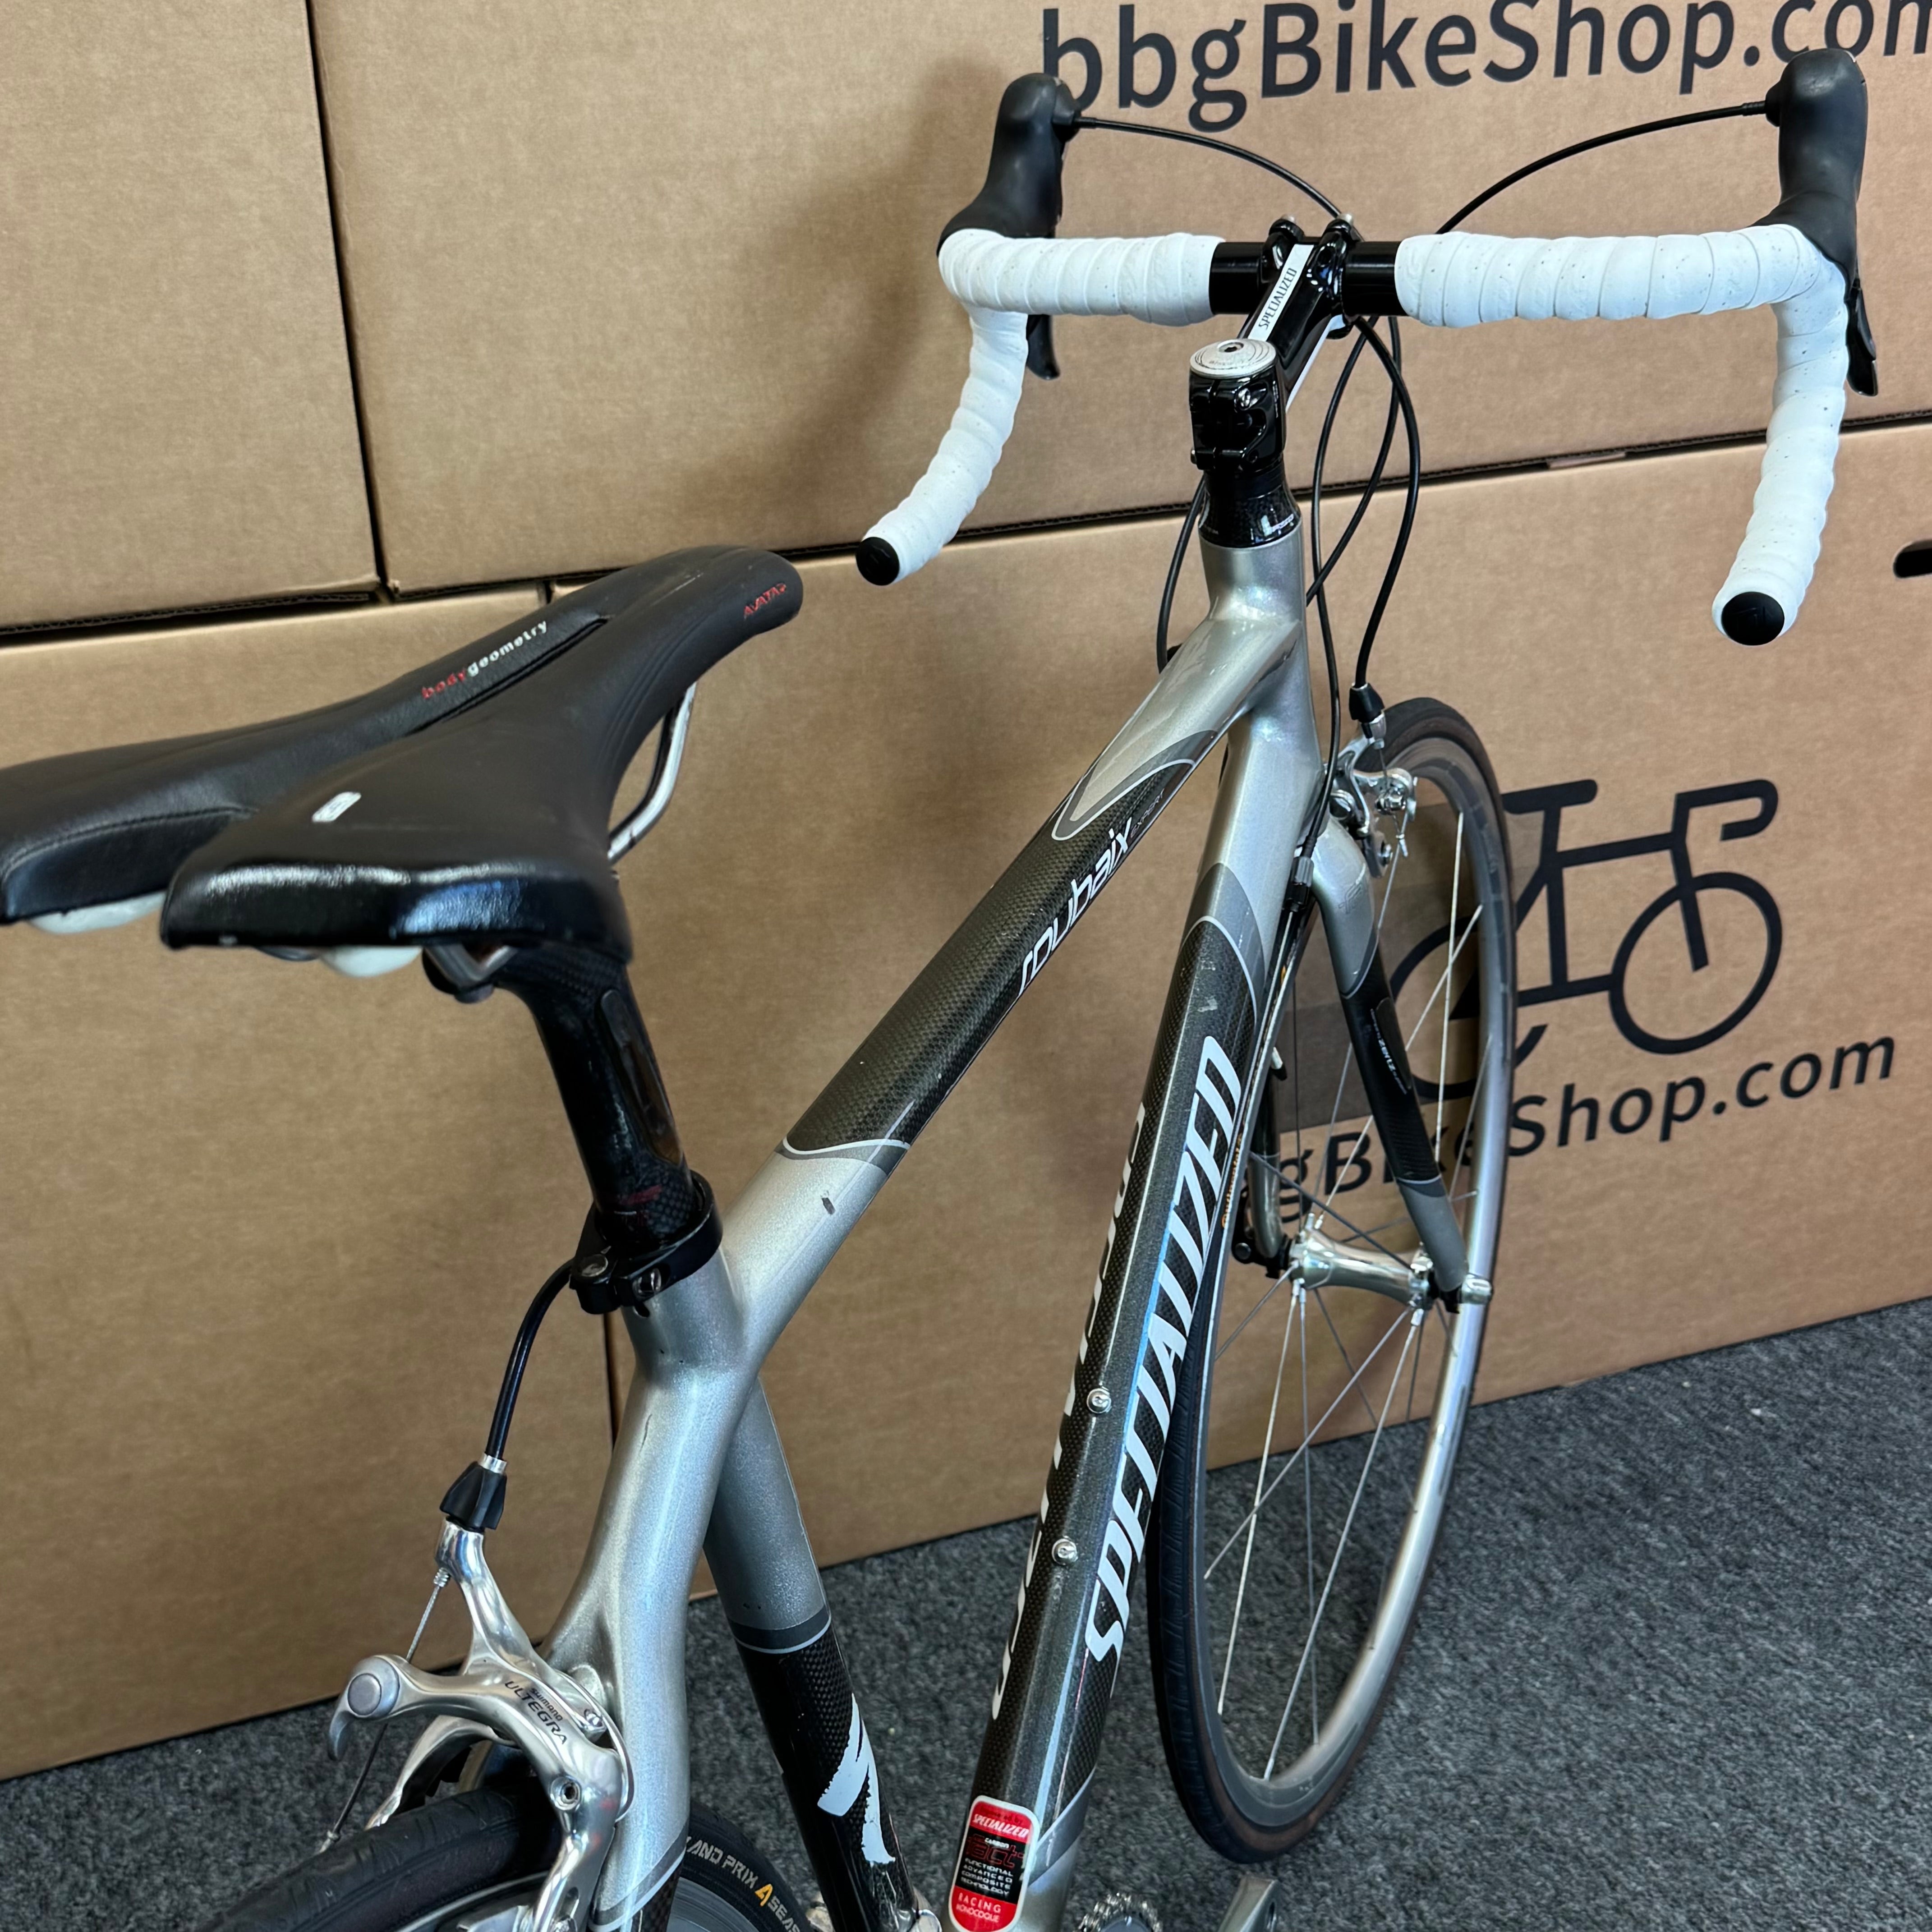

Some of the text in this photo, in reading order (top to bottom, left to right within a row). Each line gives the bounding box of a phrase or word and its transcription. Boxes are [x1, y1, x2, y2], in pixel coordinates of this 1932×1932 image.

[1043, 0, 1932, 133] bbgBikeShop.com
[1258, 267, 1297, 330] SPECIALIZED
[505, 1681, 567, 1744] ULTEGRA
[530, 1688, 563, 1721] SHIMANO
[972, 1814, 1030, 1838] SPECIALIZED
[722, 1855, 759, 1889] PRIX
[961, 1871, 1011, 1890] COMPOSITE
[963, 1864, 1013, 1883] ADVANCED
[965, 1858, 1013, 1877] FUNCTIONAL
[958, 1892, 1001, 1913] RACING
